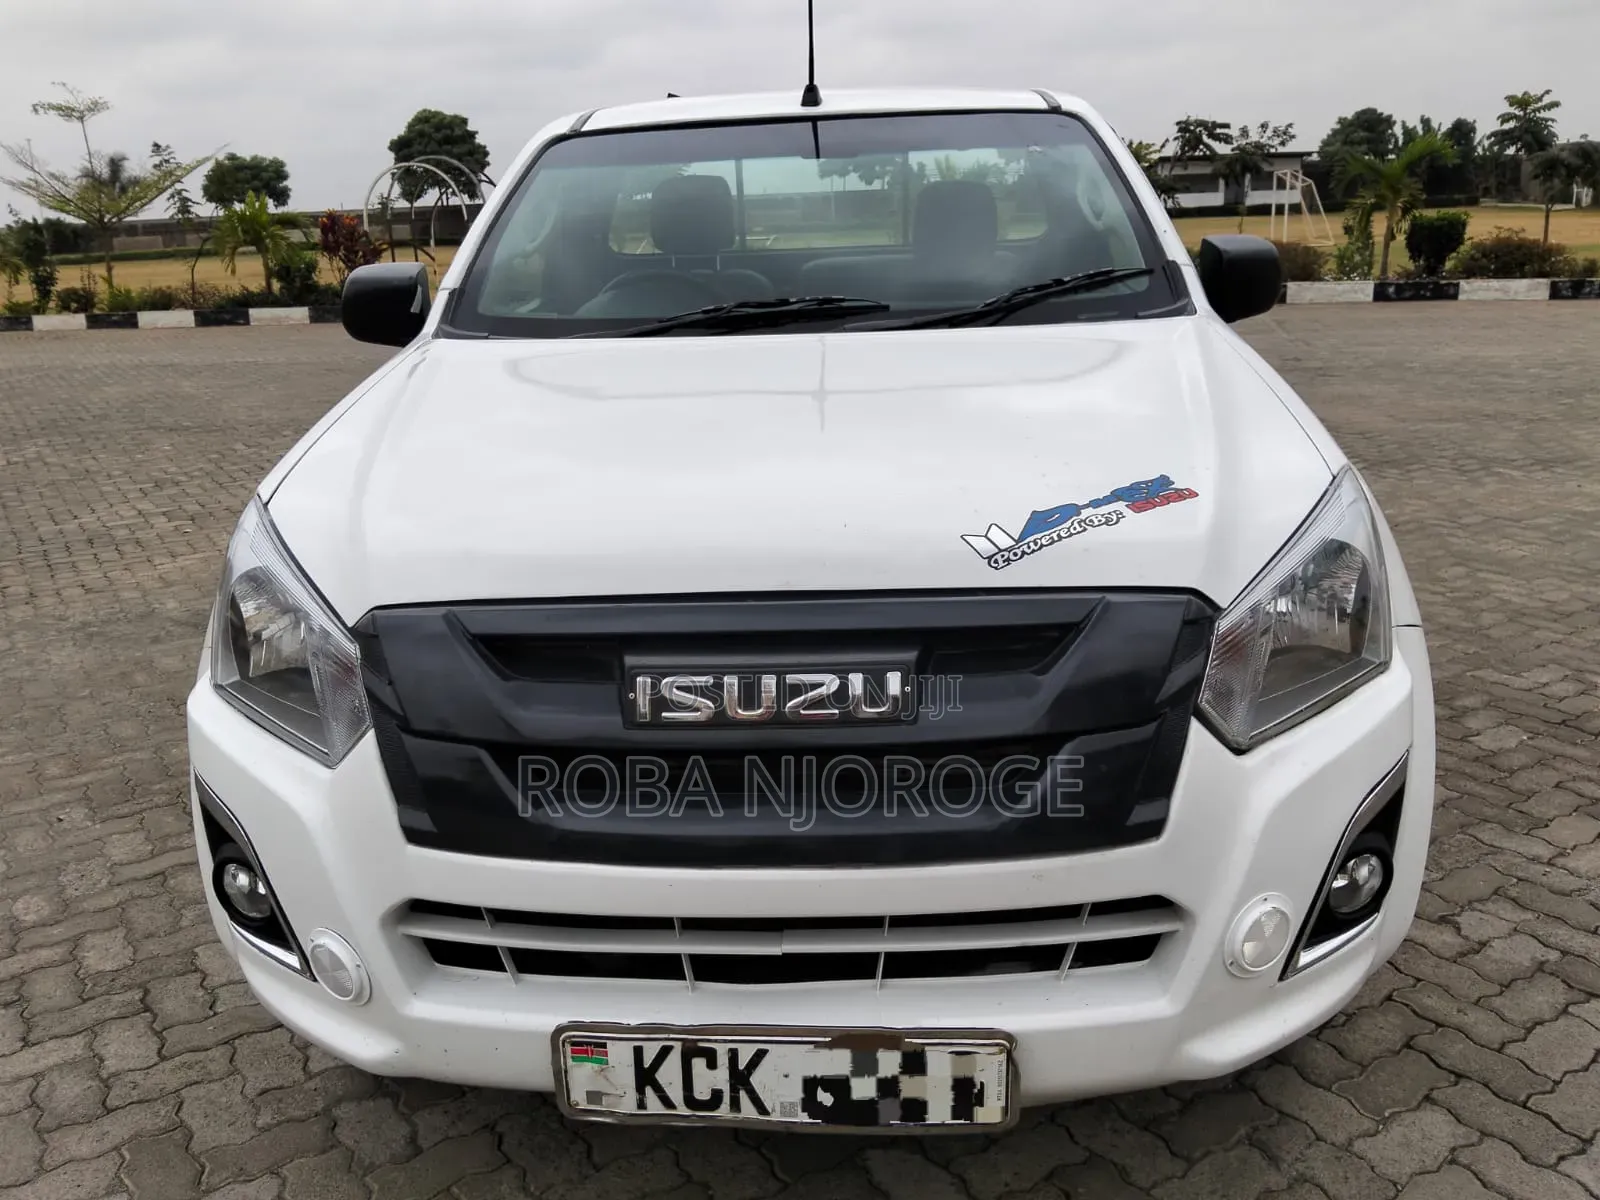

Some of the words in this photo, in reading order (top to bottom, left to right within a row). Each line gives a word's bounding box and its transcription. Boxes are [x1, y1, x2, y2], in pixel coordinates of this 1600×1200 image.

[988, 518, 1088, 570] Powered
[1084, 509, 1126, 531] By:
[1125, 487, 1199, 513] ISUZU
[635, 671, 902, 722] ISUZU
[633, 1044, 770, 1116] KCK
